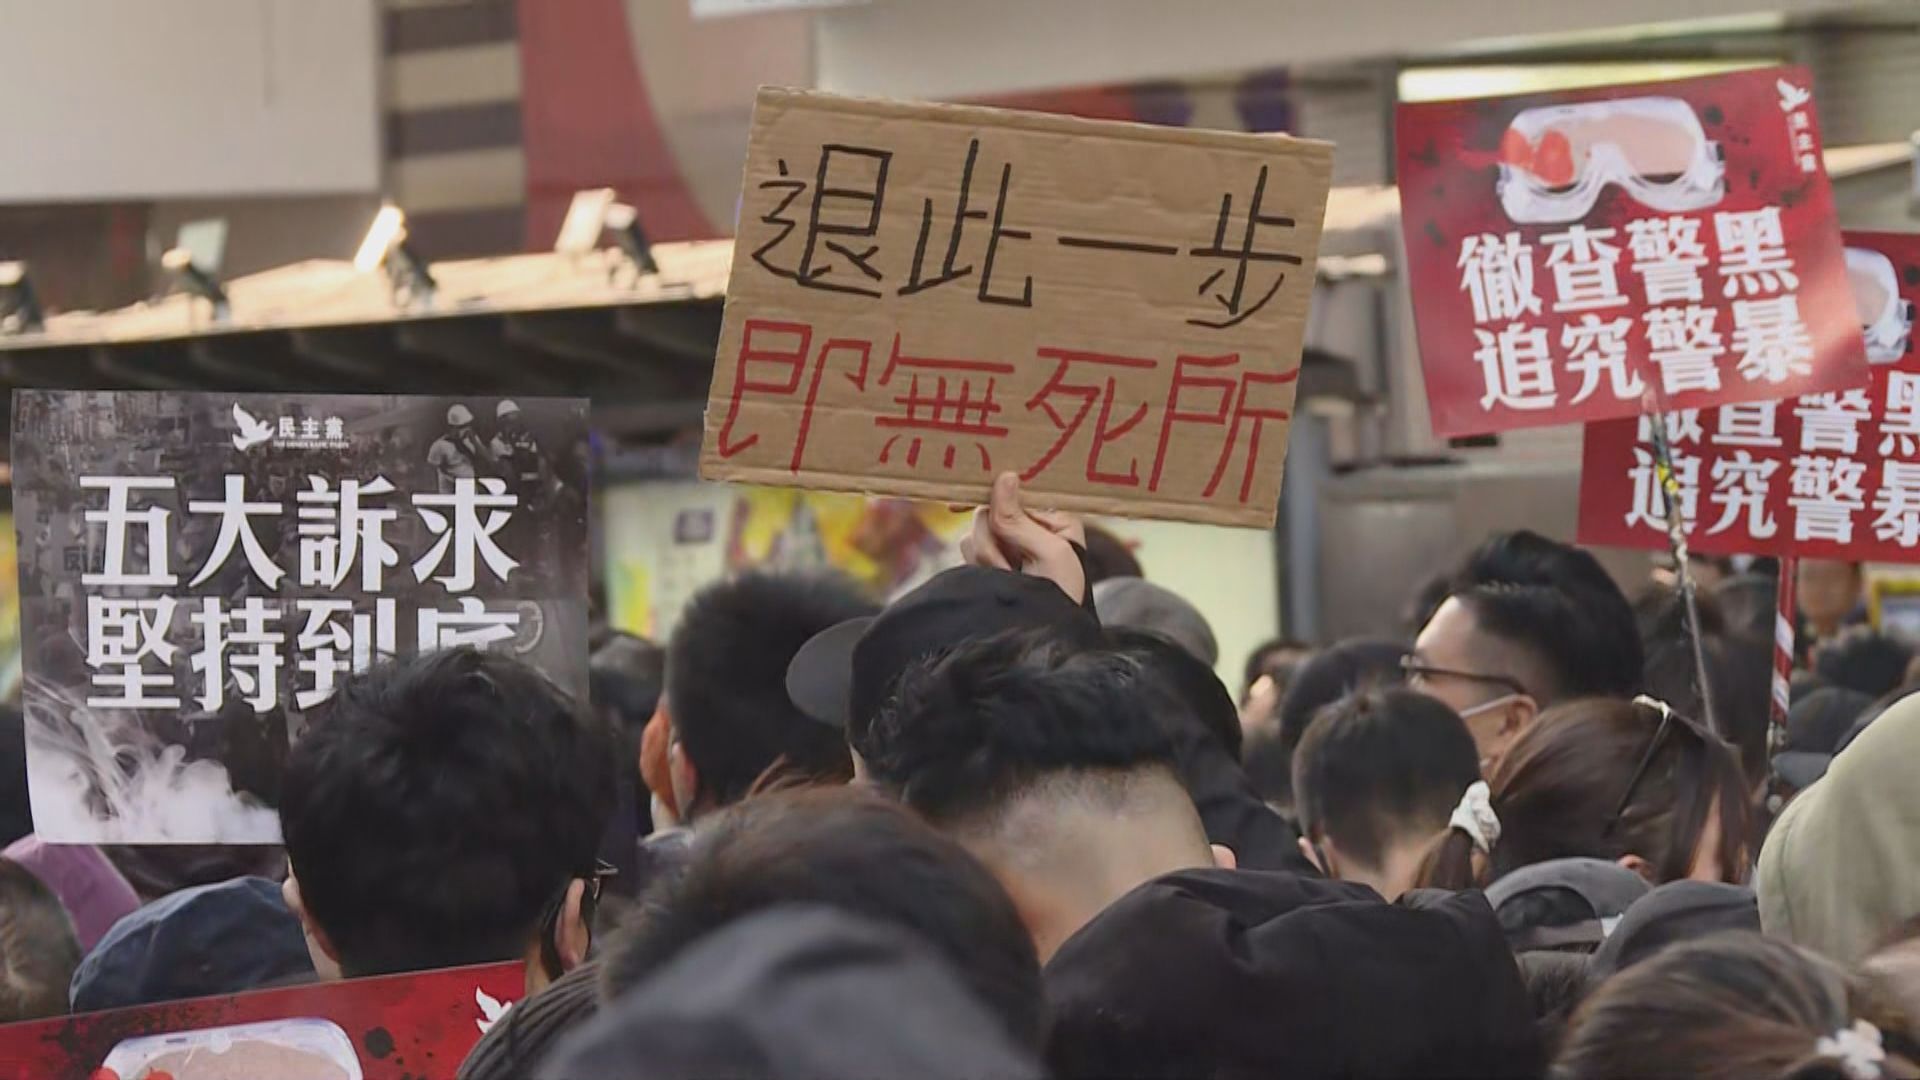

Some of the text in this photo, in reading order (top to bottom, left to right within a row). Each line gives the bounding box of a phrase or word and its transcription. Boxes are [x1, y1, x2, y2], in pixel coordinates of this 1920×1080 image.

[751, 138, 1303, 328] 退此一步
[1456, 206, 1799, 323] 徹查警黑
[718, 319, 1300, 504] 即無死所
[1472, 294, 1815, 411] 追究警暴
[79, 473, 520, 592] 五大訴求
